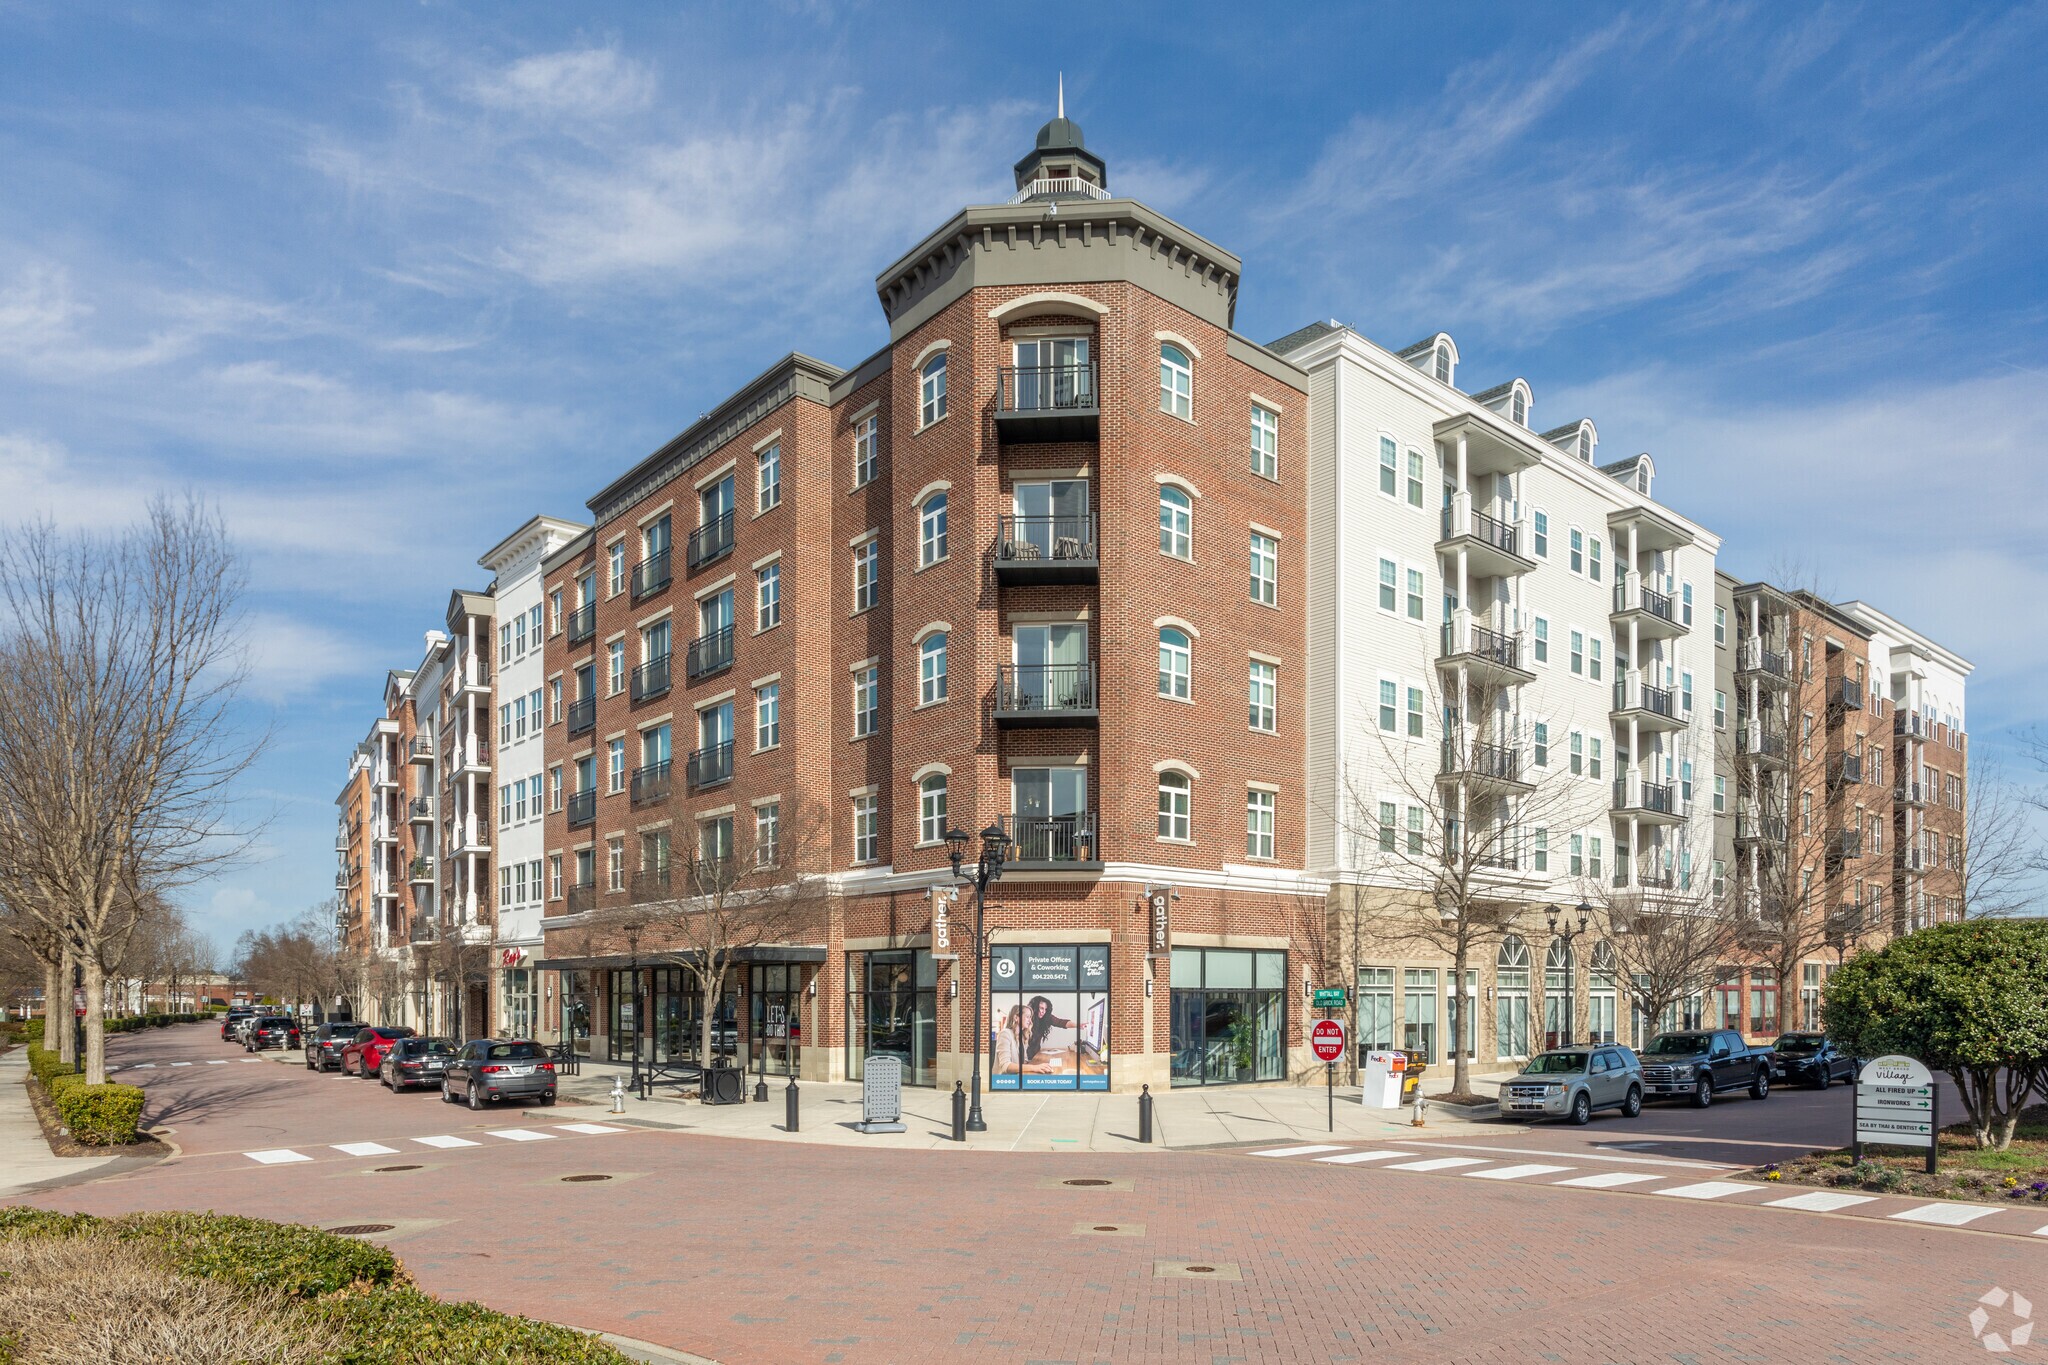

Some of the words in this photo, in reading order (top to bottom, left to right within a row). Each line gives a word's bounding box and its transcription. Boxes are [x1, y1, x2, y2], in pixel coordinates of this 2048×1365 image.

[935, 896, 949, 948] gather.
[1153, 896, 1168, 949] gather.
[1037, 964, 1069, 972] Coworking
[766, 1005, 785, 1024] LET'S
[1316, 1028, 1325, 1036] DO
[1326, 1028, 1339, 1036] NOT
[1318, 1046, 1337, 1054] ENTER
[1371, 1055, 1387, 1063] FedEx
